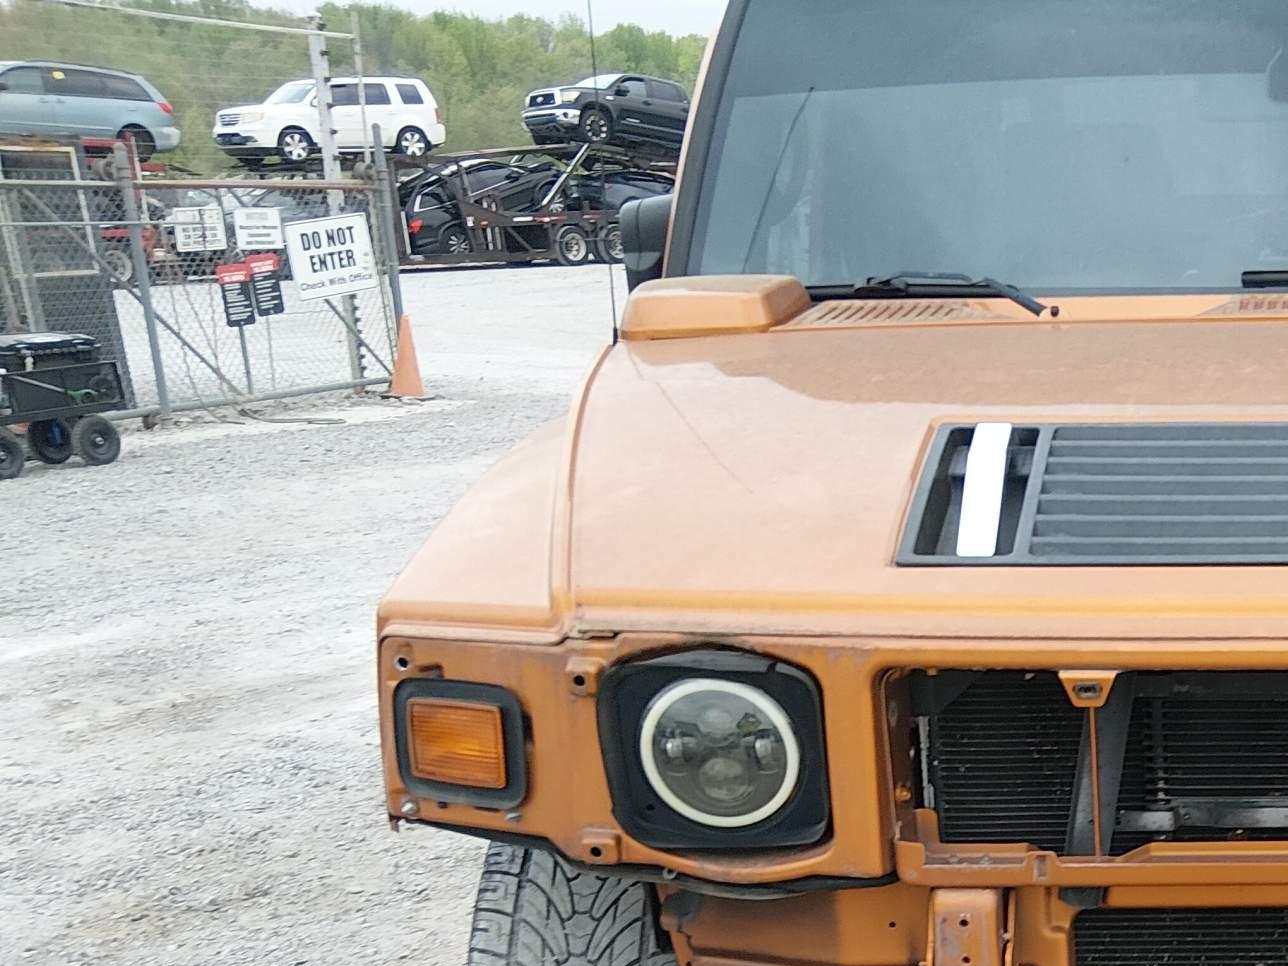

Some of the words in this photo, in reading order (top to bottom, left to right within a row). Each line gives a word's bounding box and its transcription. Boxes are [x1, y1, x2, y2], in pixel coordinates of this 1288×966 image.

[300, 231, 322, 252] DO
[325, 225, 355, 248] NOT
[309, 249, 357, 274] ENTER
